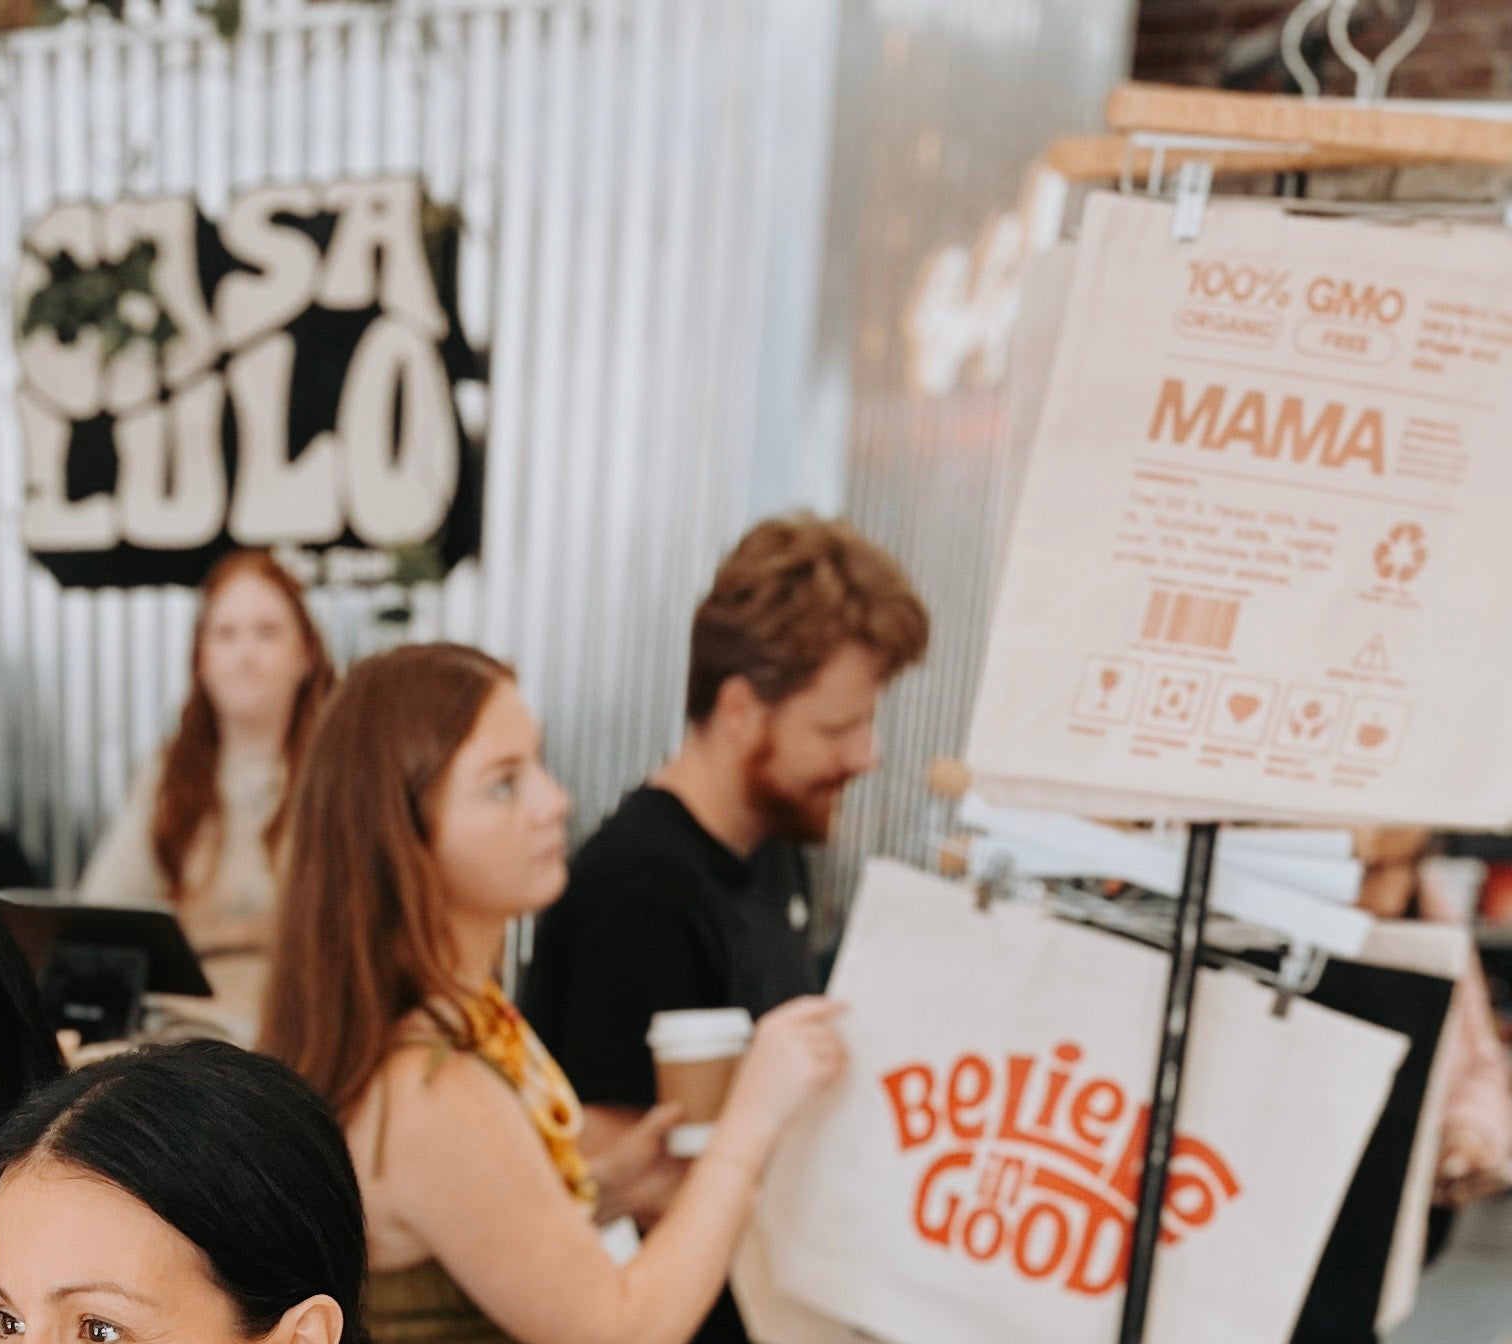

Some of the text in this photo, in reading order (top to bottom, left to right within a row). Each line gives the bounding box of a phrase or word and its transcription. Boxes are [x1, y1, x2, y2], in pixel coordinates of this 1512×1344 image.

[1179, 307, 1372, 357] ORGANIC FREE
[1187, 259, 1292, 309] 100%
[1305, 275, 1407, 326] GMO
[19, 314, 460, 552] LULO
[1146, 377, 1386, 477] MAMA
